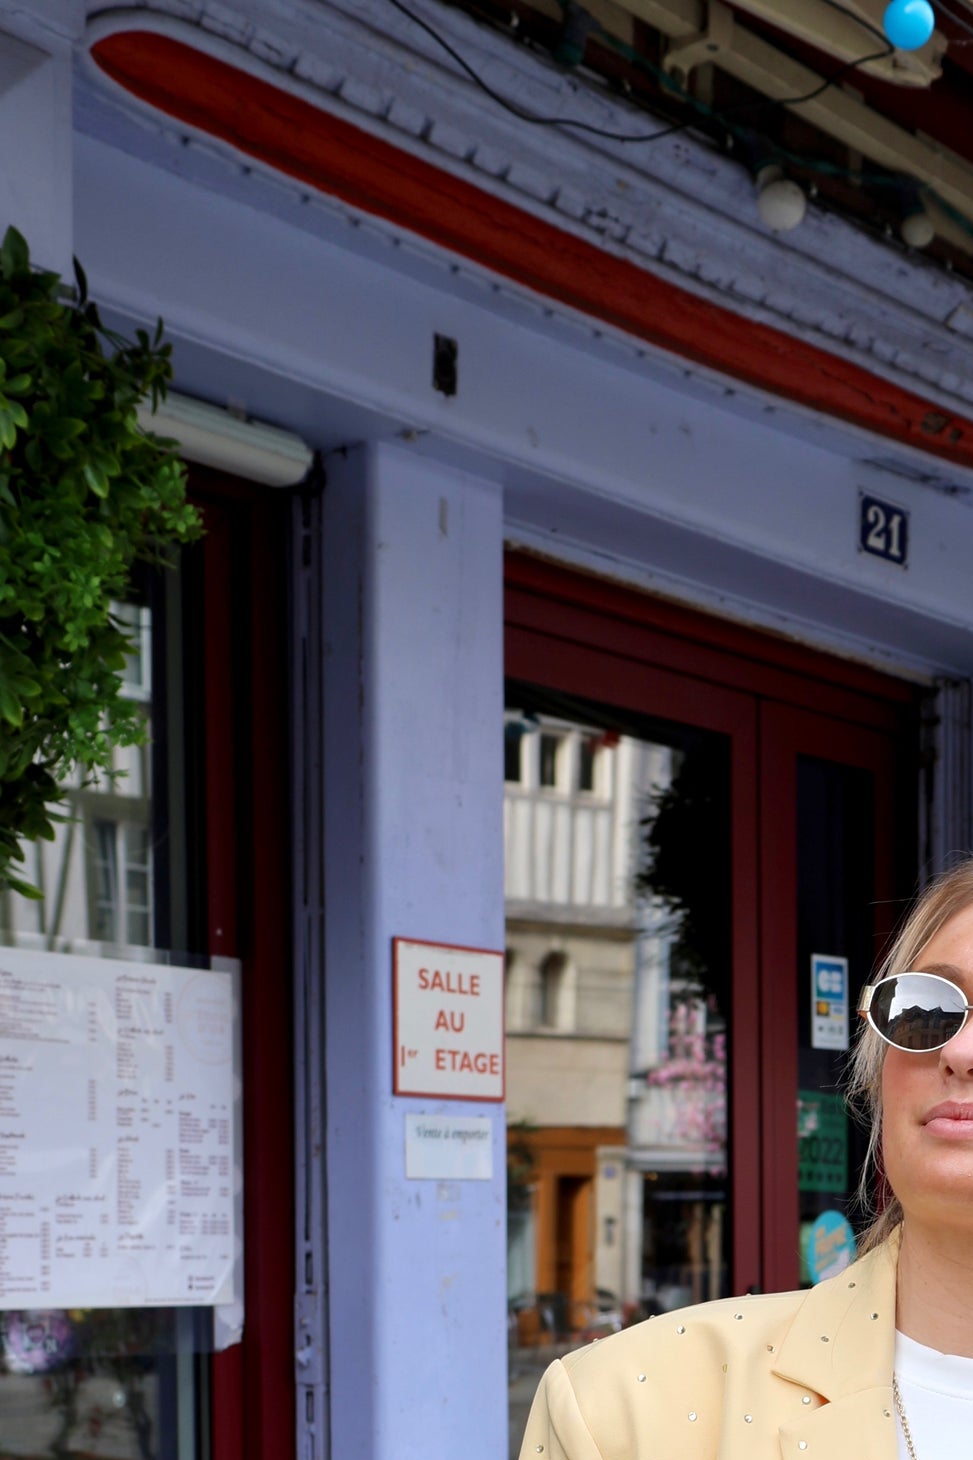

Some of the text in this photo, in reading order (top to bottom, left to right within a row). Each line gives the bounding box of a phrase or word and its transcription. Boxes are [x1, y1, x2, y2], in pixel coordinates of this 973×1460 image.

[867, 505, 902, 557] 21
[418, 967, 481, 997] SALLE
[434, 1009, 465, 1034] AU
[435, 1048, 501, 1076] ETAGE
